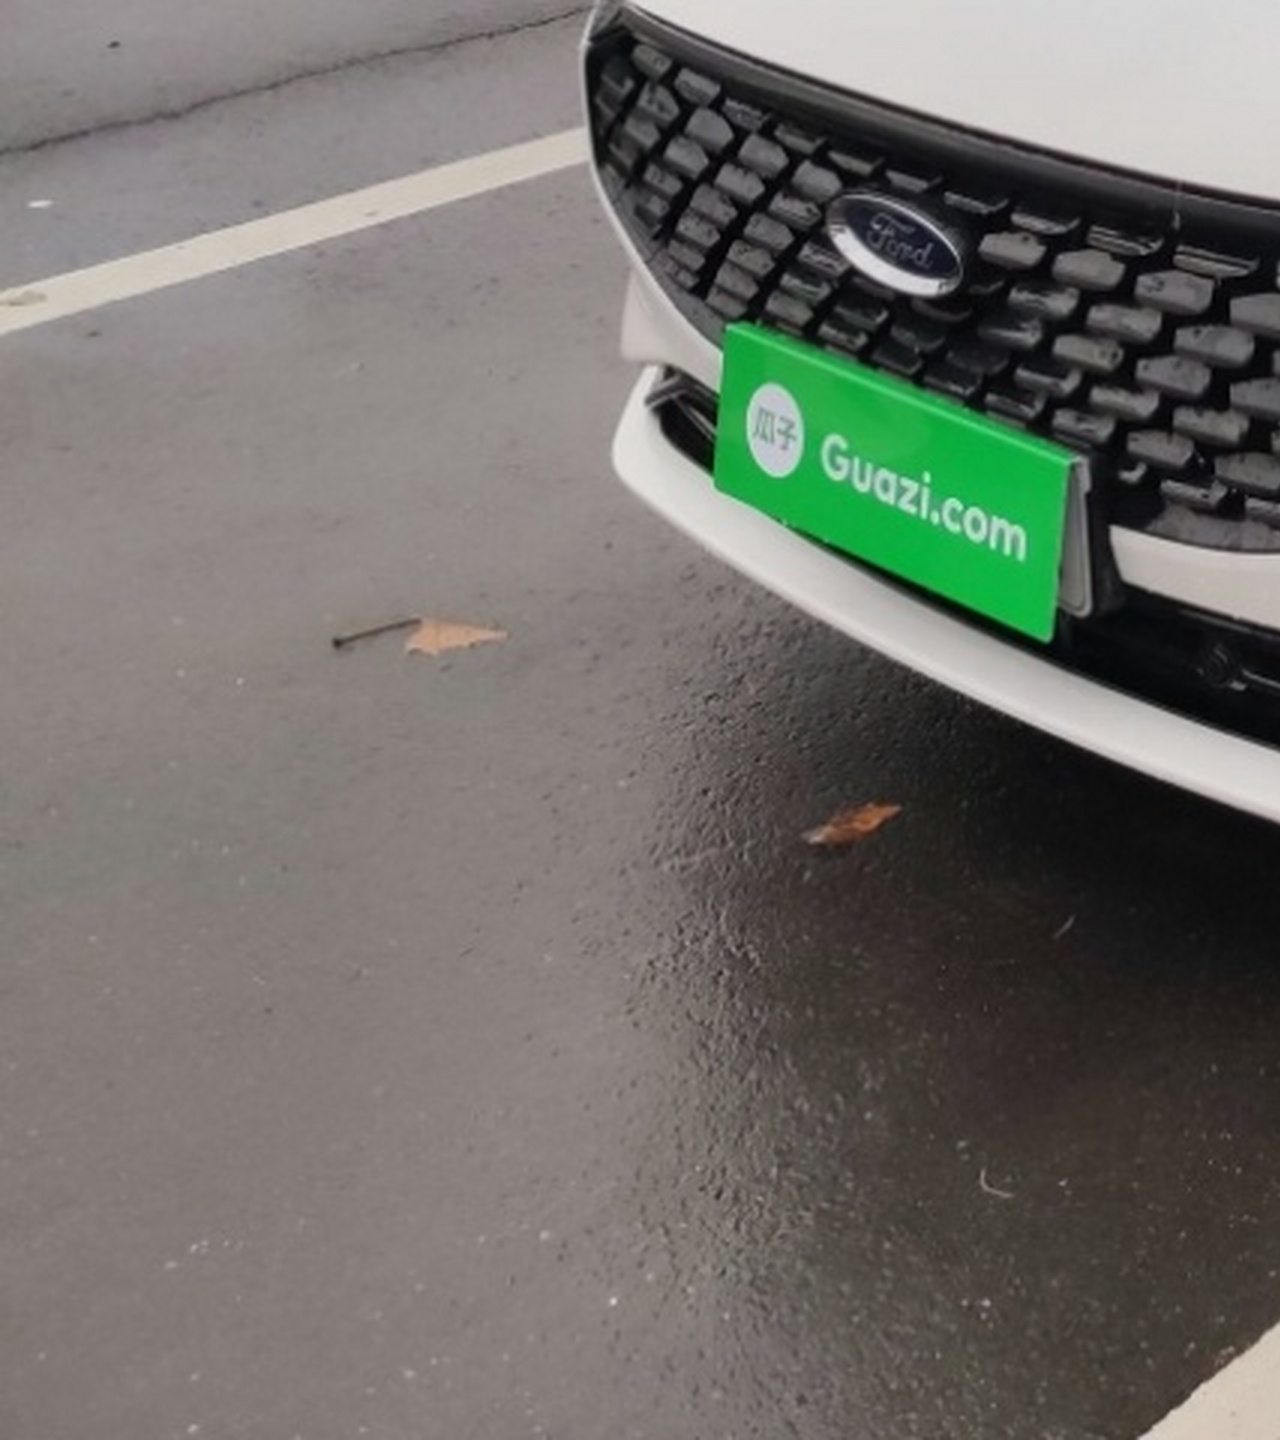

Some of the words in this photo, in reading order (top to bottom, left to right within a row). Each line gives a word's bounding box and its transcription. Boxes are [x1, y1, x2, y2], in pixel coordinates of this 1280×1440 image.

[866, 212, 935, 269] Ford
[752, 407, 798, 451] 瓜子
[820, 433, 1027, 563] Guazi.com
